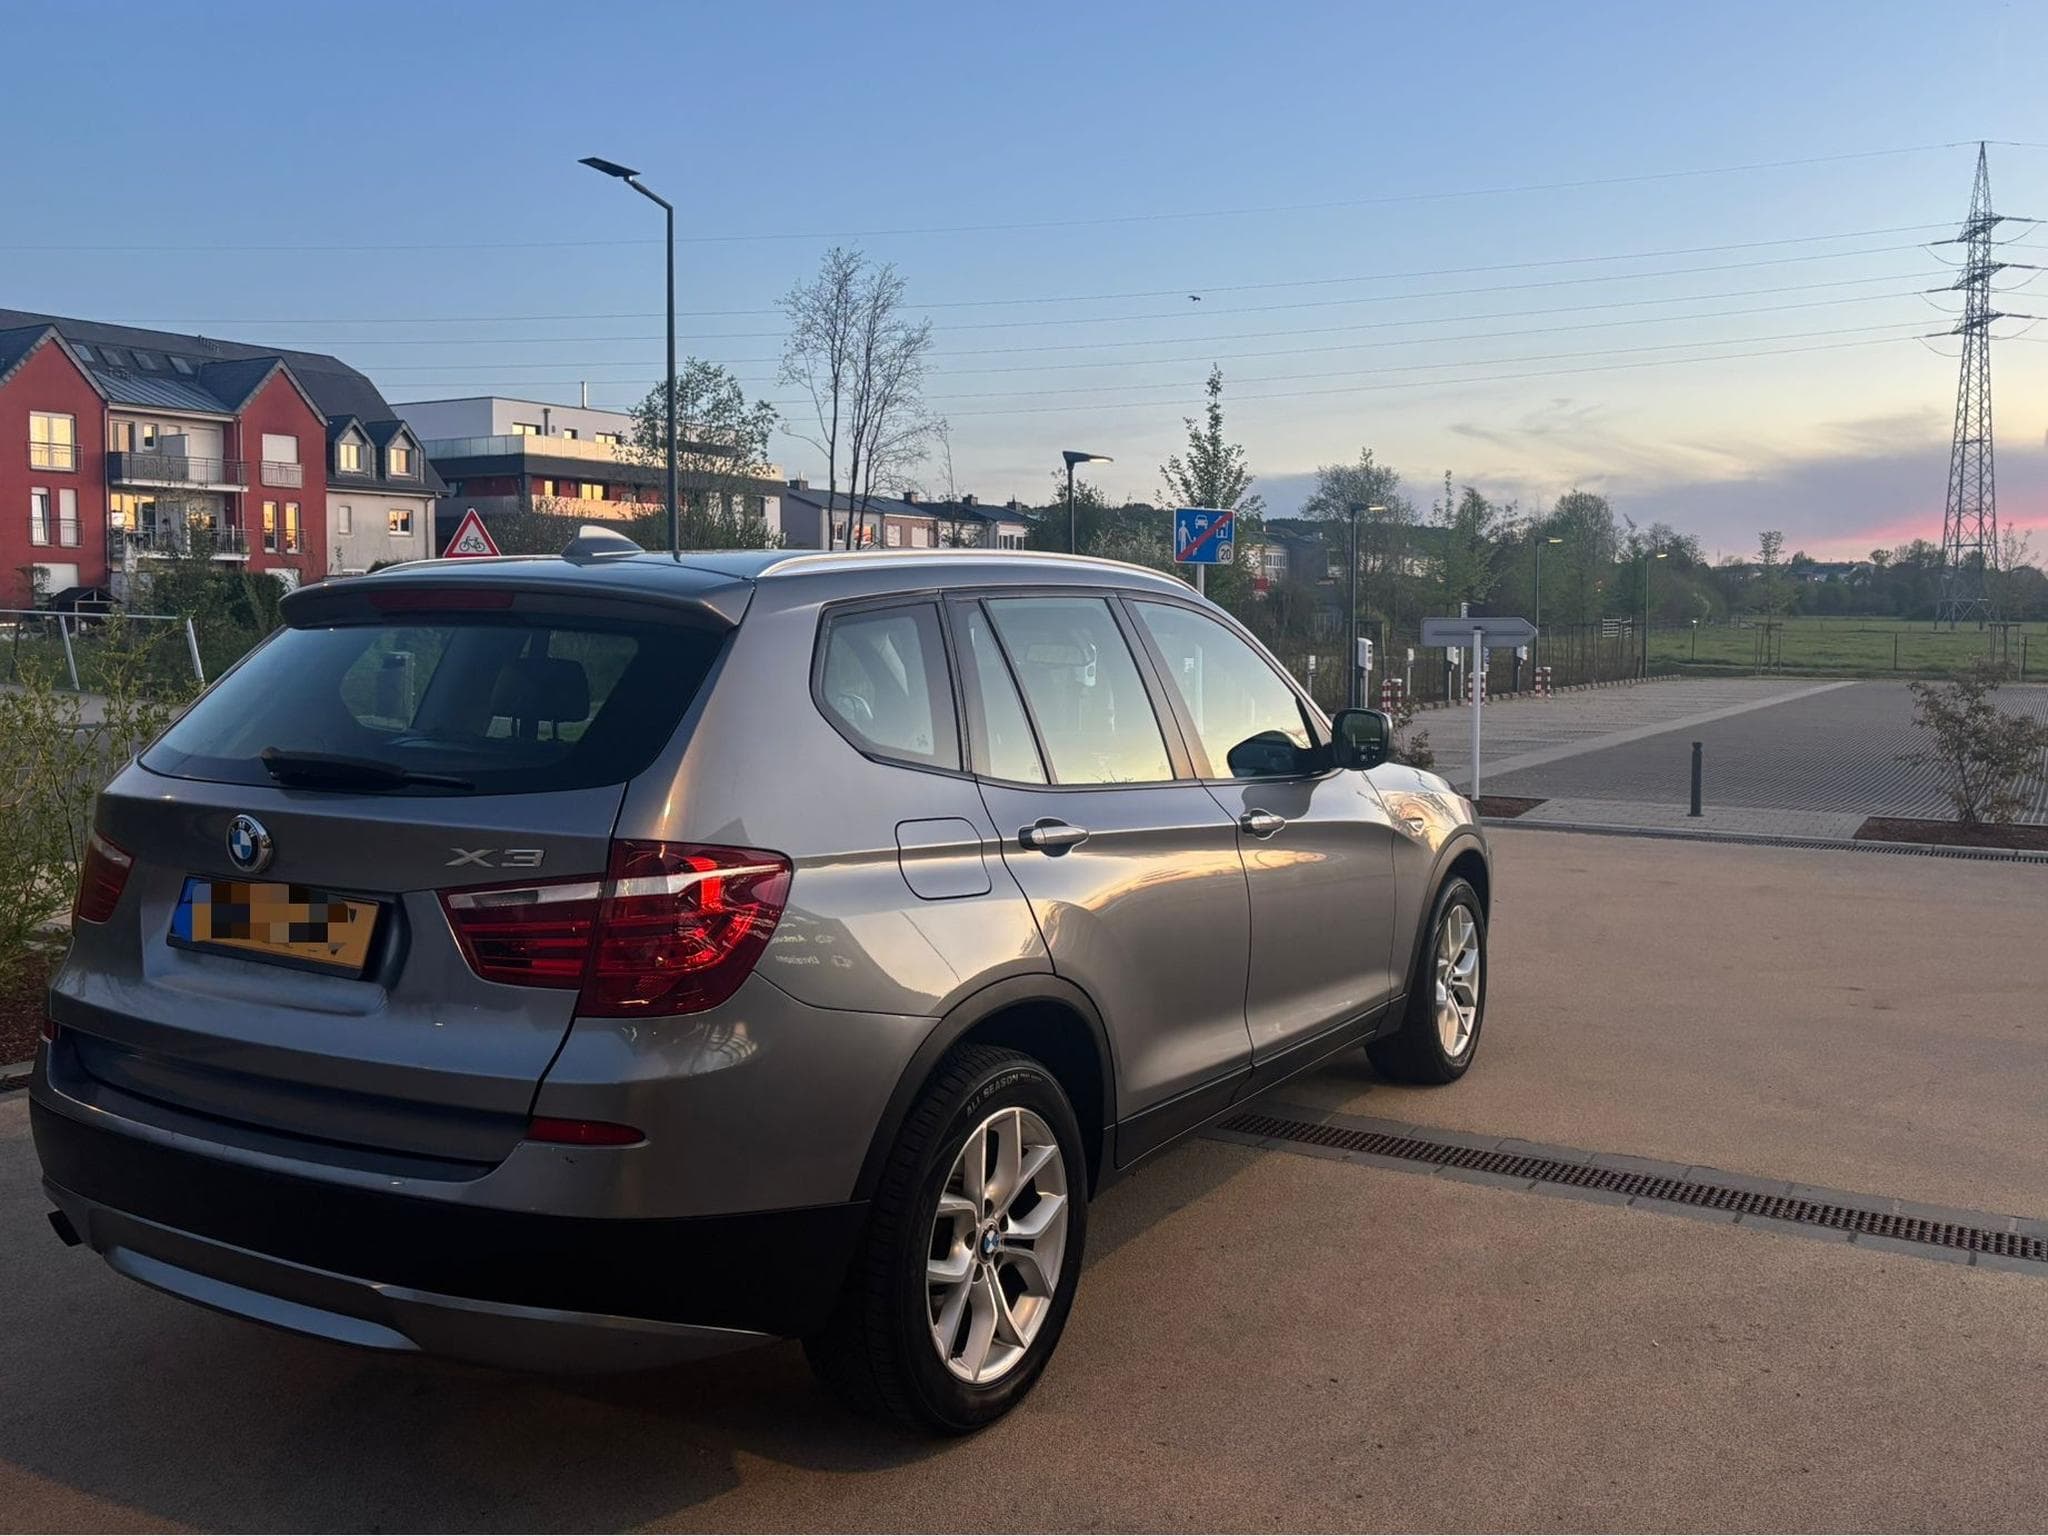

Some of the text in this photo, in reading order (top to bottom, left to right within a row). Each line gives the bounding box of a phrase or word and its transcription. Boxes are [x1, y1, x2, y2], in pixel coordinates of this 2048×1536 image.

[1221, 548, 1231, 561] 20
[443, 848, 544, 869] X3
[982, 1073, 1019, 1098] SEASON
